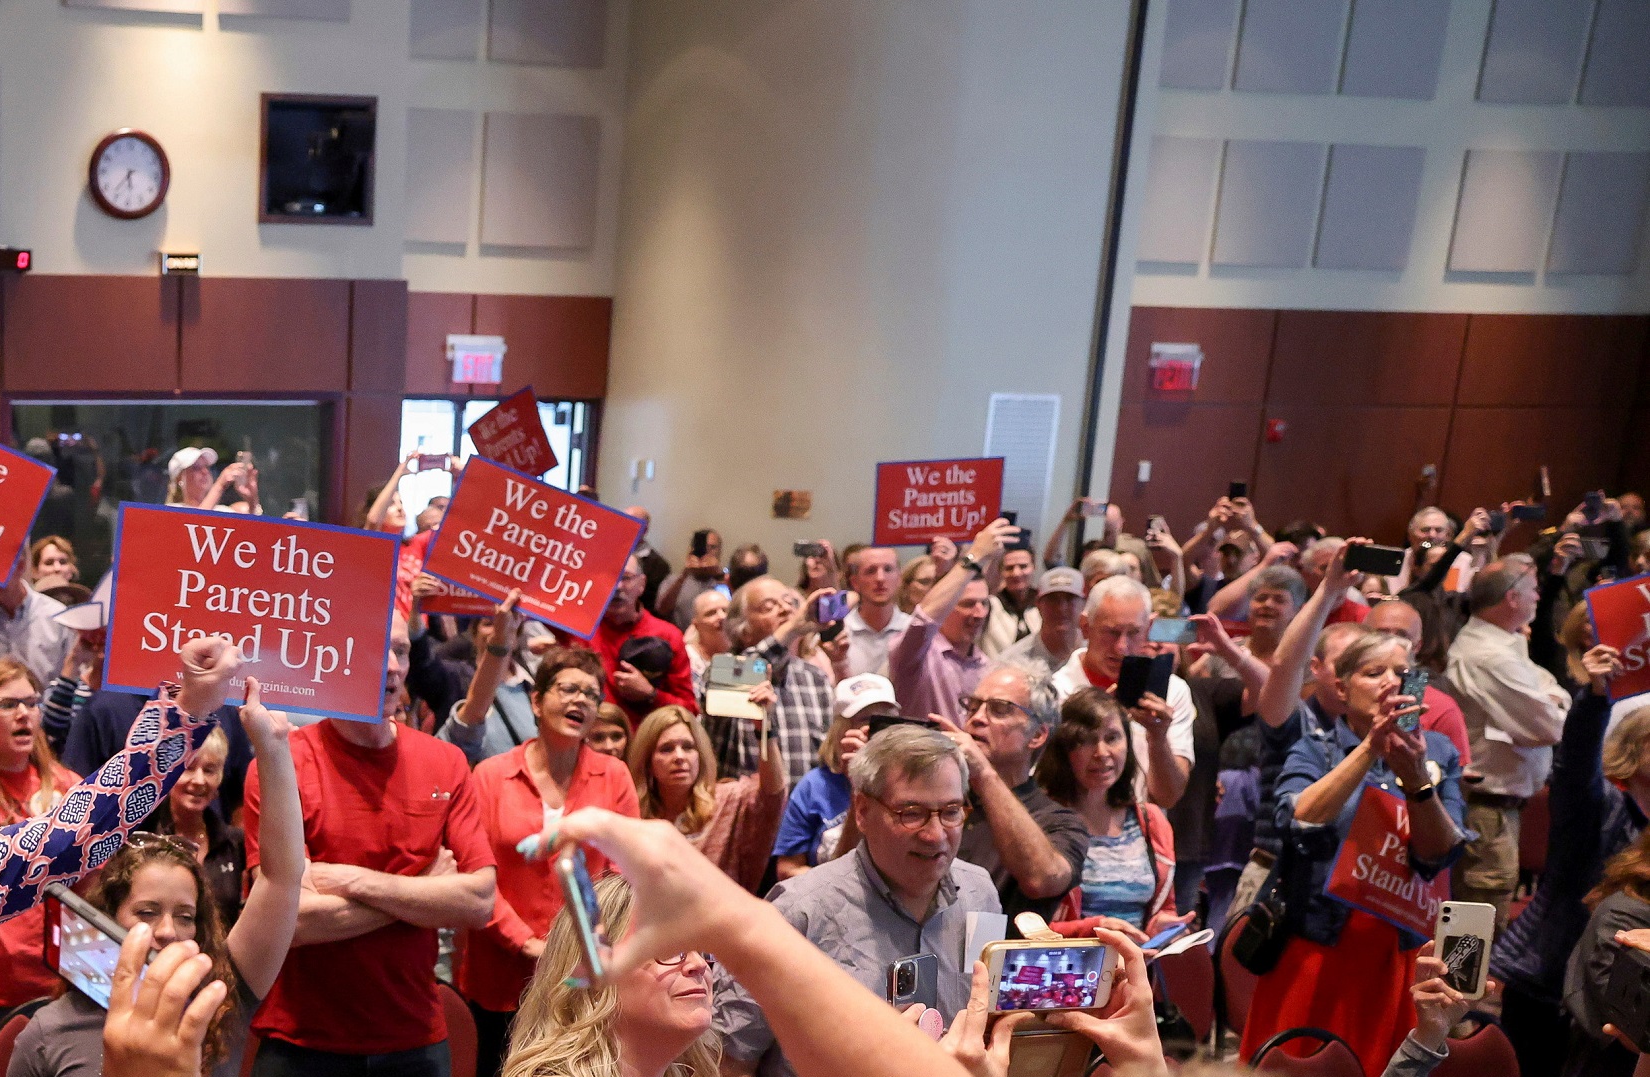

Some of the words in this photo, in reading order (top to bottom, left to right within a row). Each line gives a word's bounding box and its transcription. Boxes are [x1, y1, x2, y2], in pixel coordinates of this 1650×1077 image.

[903, 487, 976, 508] Parents
[907, 465, 941, 486] We
[945, 464, 977, 484] the
[505, 478, 549, 519] We
[554, 504, 598, 539] the
[887, 507, 945, 530] Stand
[951, 505, 987, 531] Up!
[184, 523, 257, 568] We
[271, 534, 335, 578] the
[483, 507, 587, 570] Parents
[452, 530, 536, 583] Stand
[539, 563, 593, 606] Up!
[174, 569, 332, 626] Parents
[278, 627, 355, 684] Up!
[1351, 853, 1420, 901] Stand
